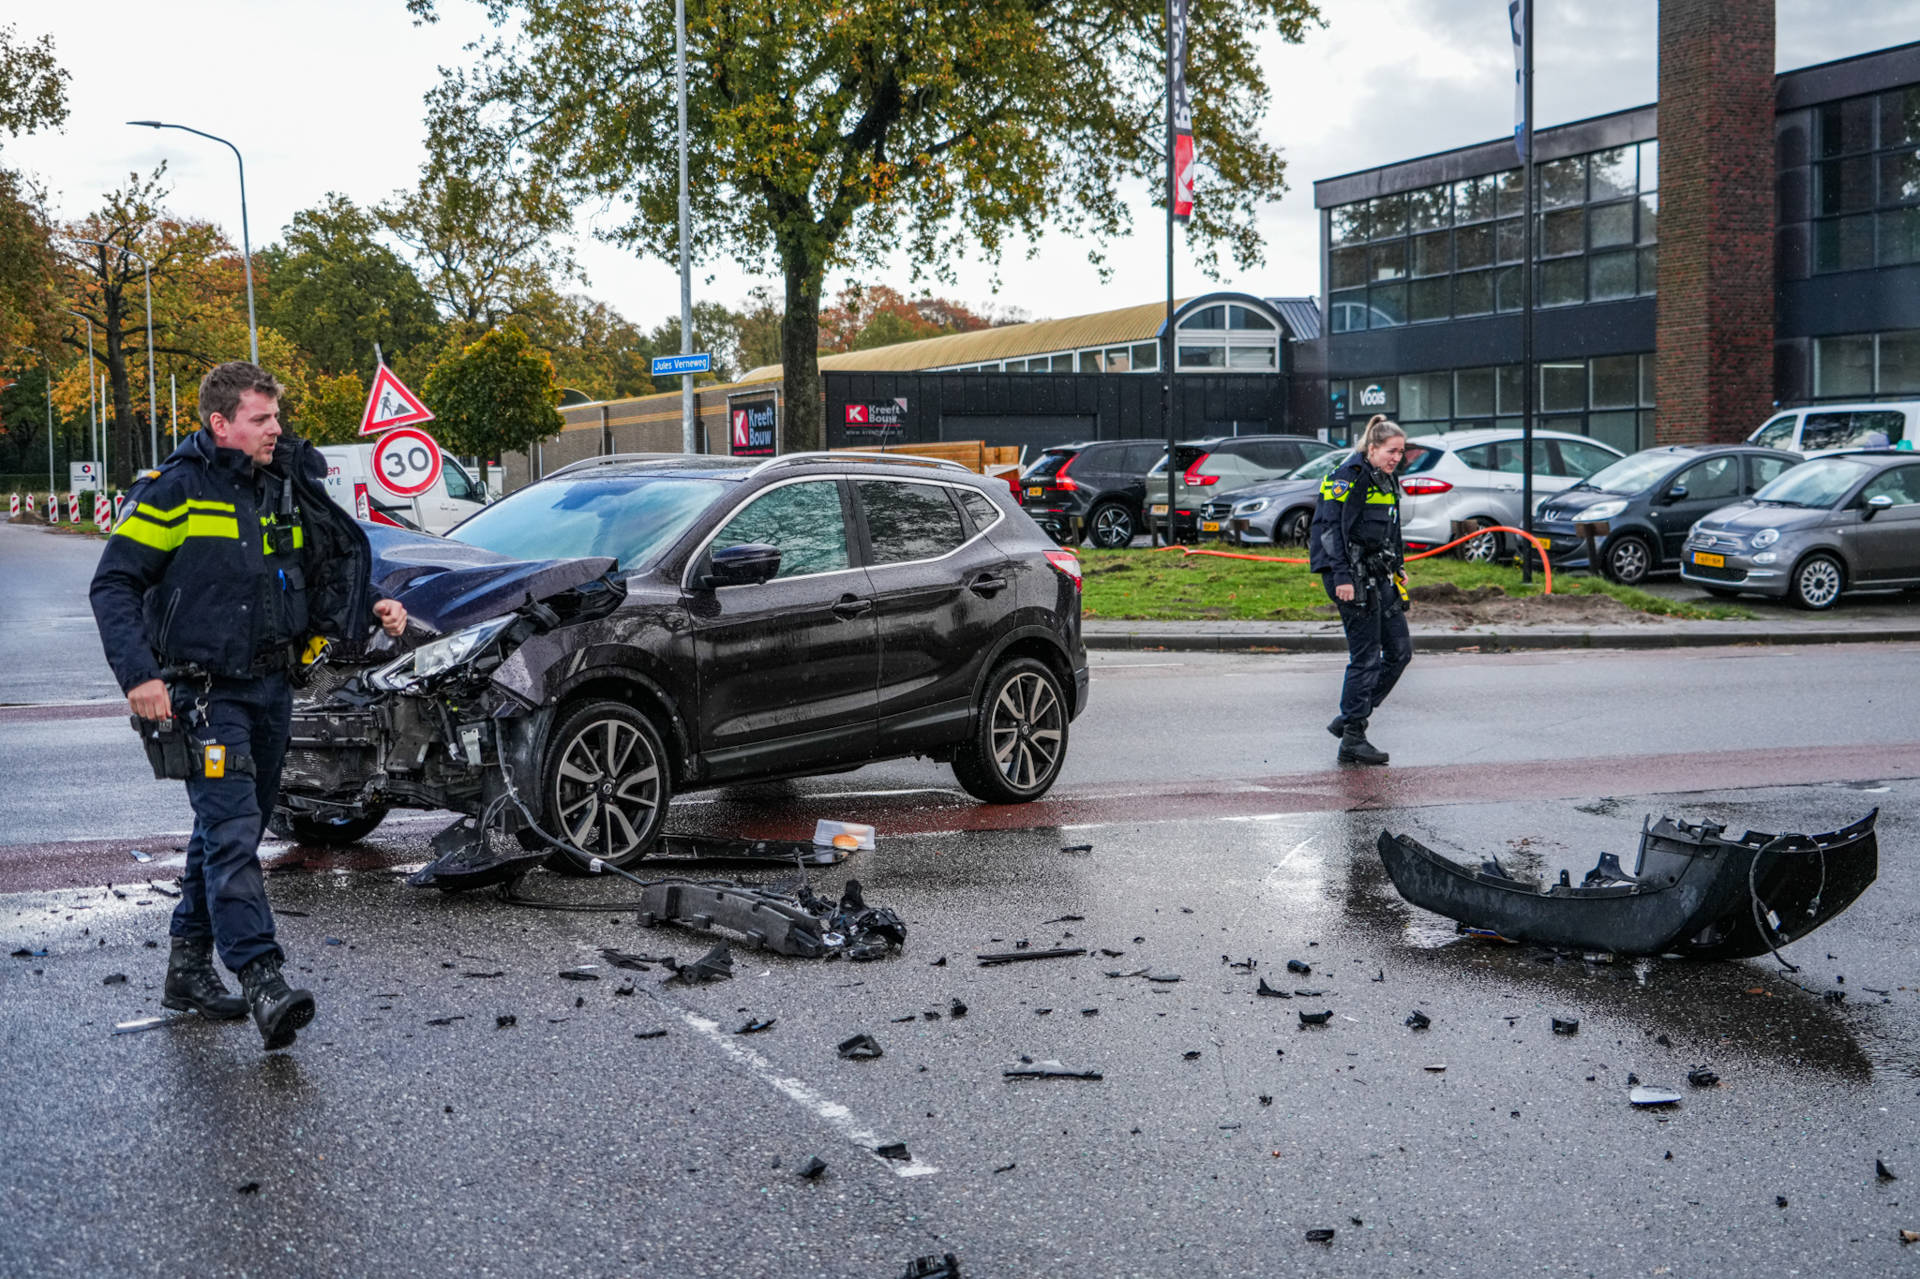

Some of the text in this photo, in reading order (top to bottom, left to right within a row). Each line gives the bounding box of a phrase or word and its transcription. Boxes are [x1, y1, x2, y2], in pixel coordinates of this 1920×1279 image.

[655, 358, 707, 371] Jules Verneweg
[749, 406, 773, 426] Kreeft
[849, 406, 863, 421] K
[869, 405, 899, 414] Kreeft
[869, 414, 897, 423] Bouw
[735, 411, 747, 444] K
[749, 427, 772, 446] Bouw
[385, 447, 430, 476] 30
